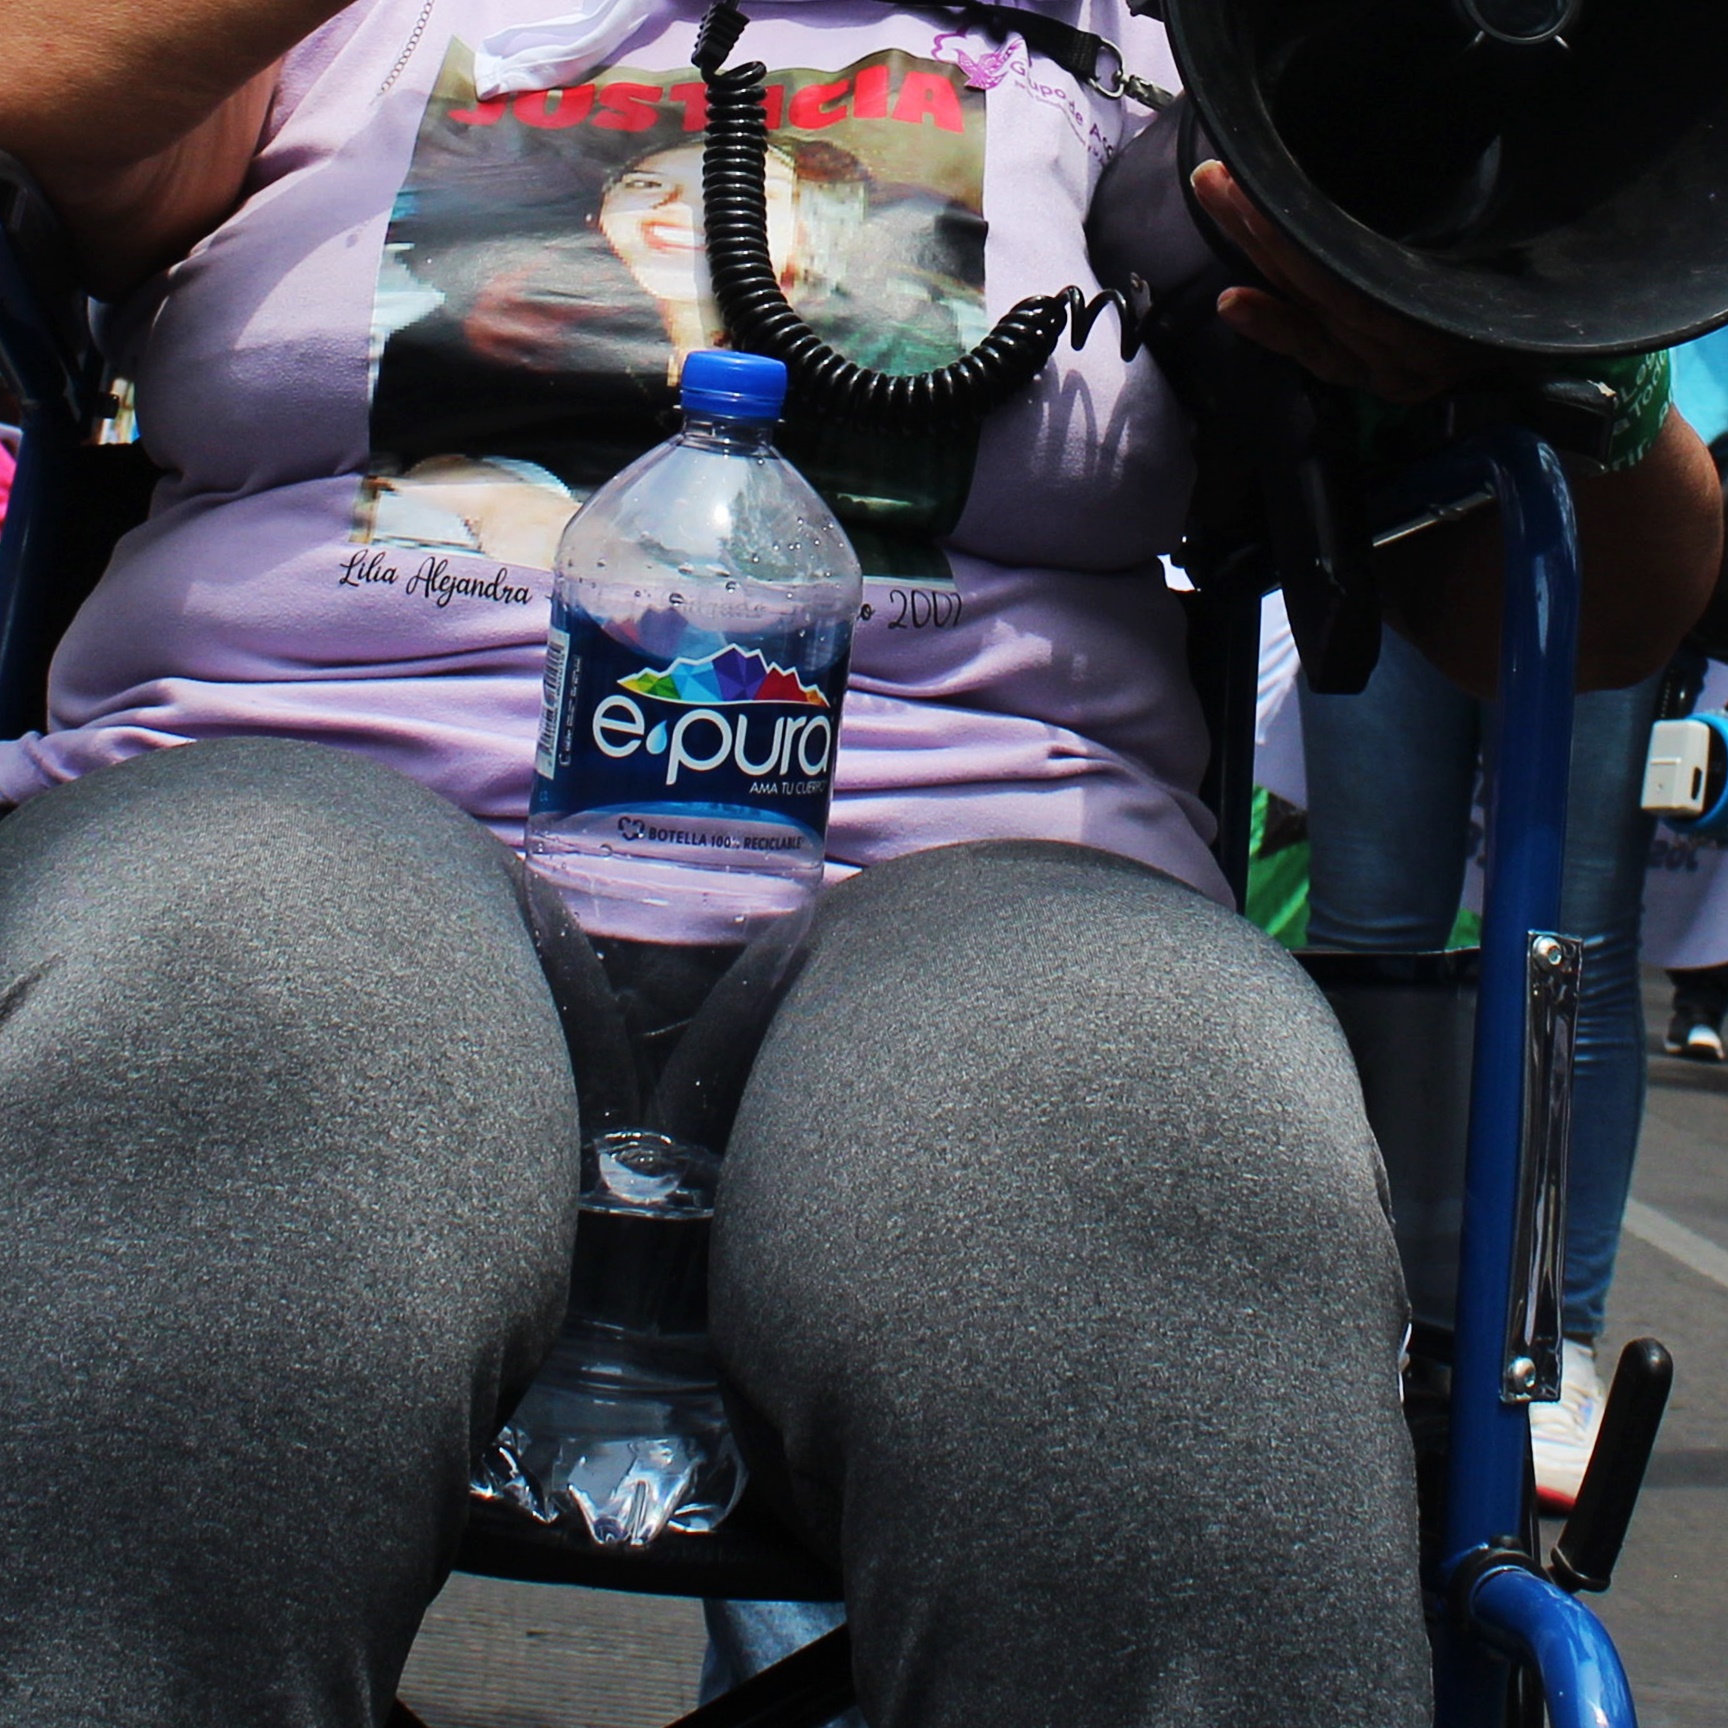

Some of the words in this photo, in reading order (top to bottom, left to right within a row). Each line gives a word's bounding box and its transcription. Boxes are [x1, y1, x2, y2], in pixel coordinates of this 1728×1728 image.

[337, 549, 400, 589] Lilia
[406, 559, 533, 610] Alejandra
[749, 780, 778, 795] AMA
[780, 780, 794, 795] TU
[648, 826, 708, 847] BOTELLA
[743, 836, 803, 850] RECICLABLE
